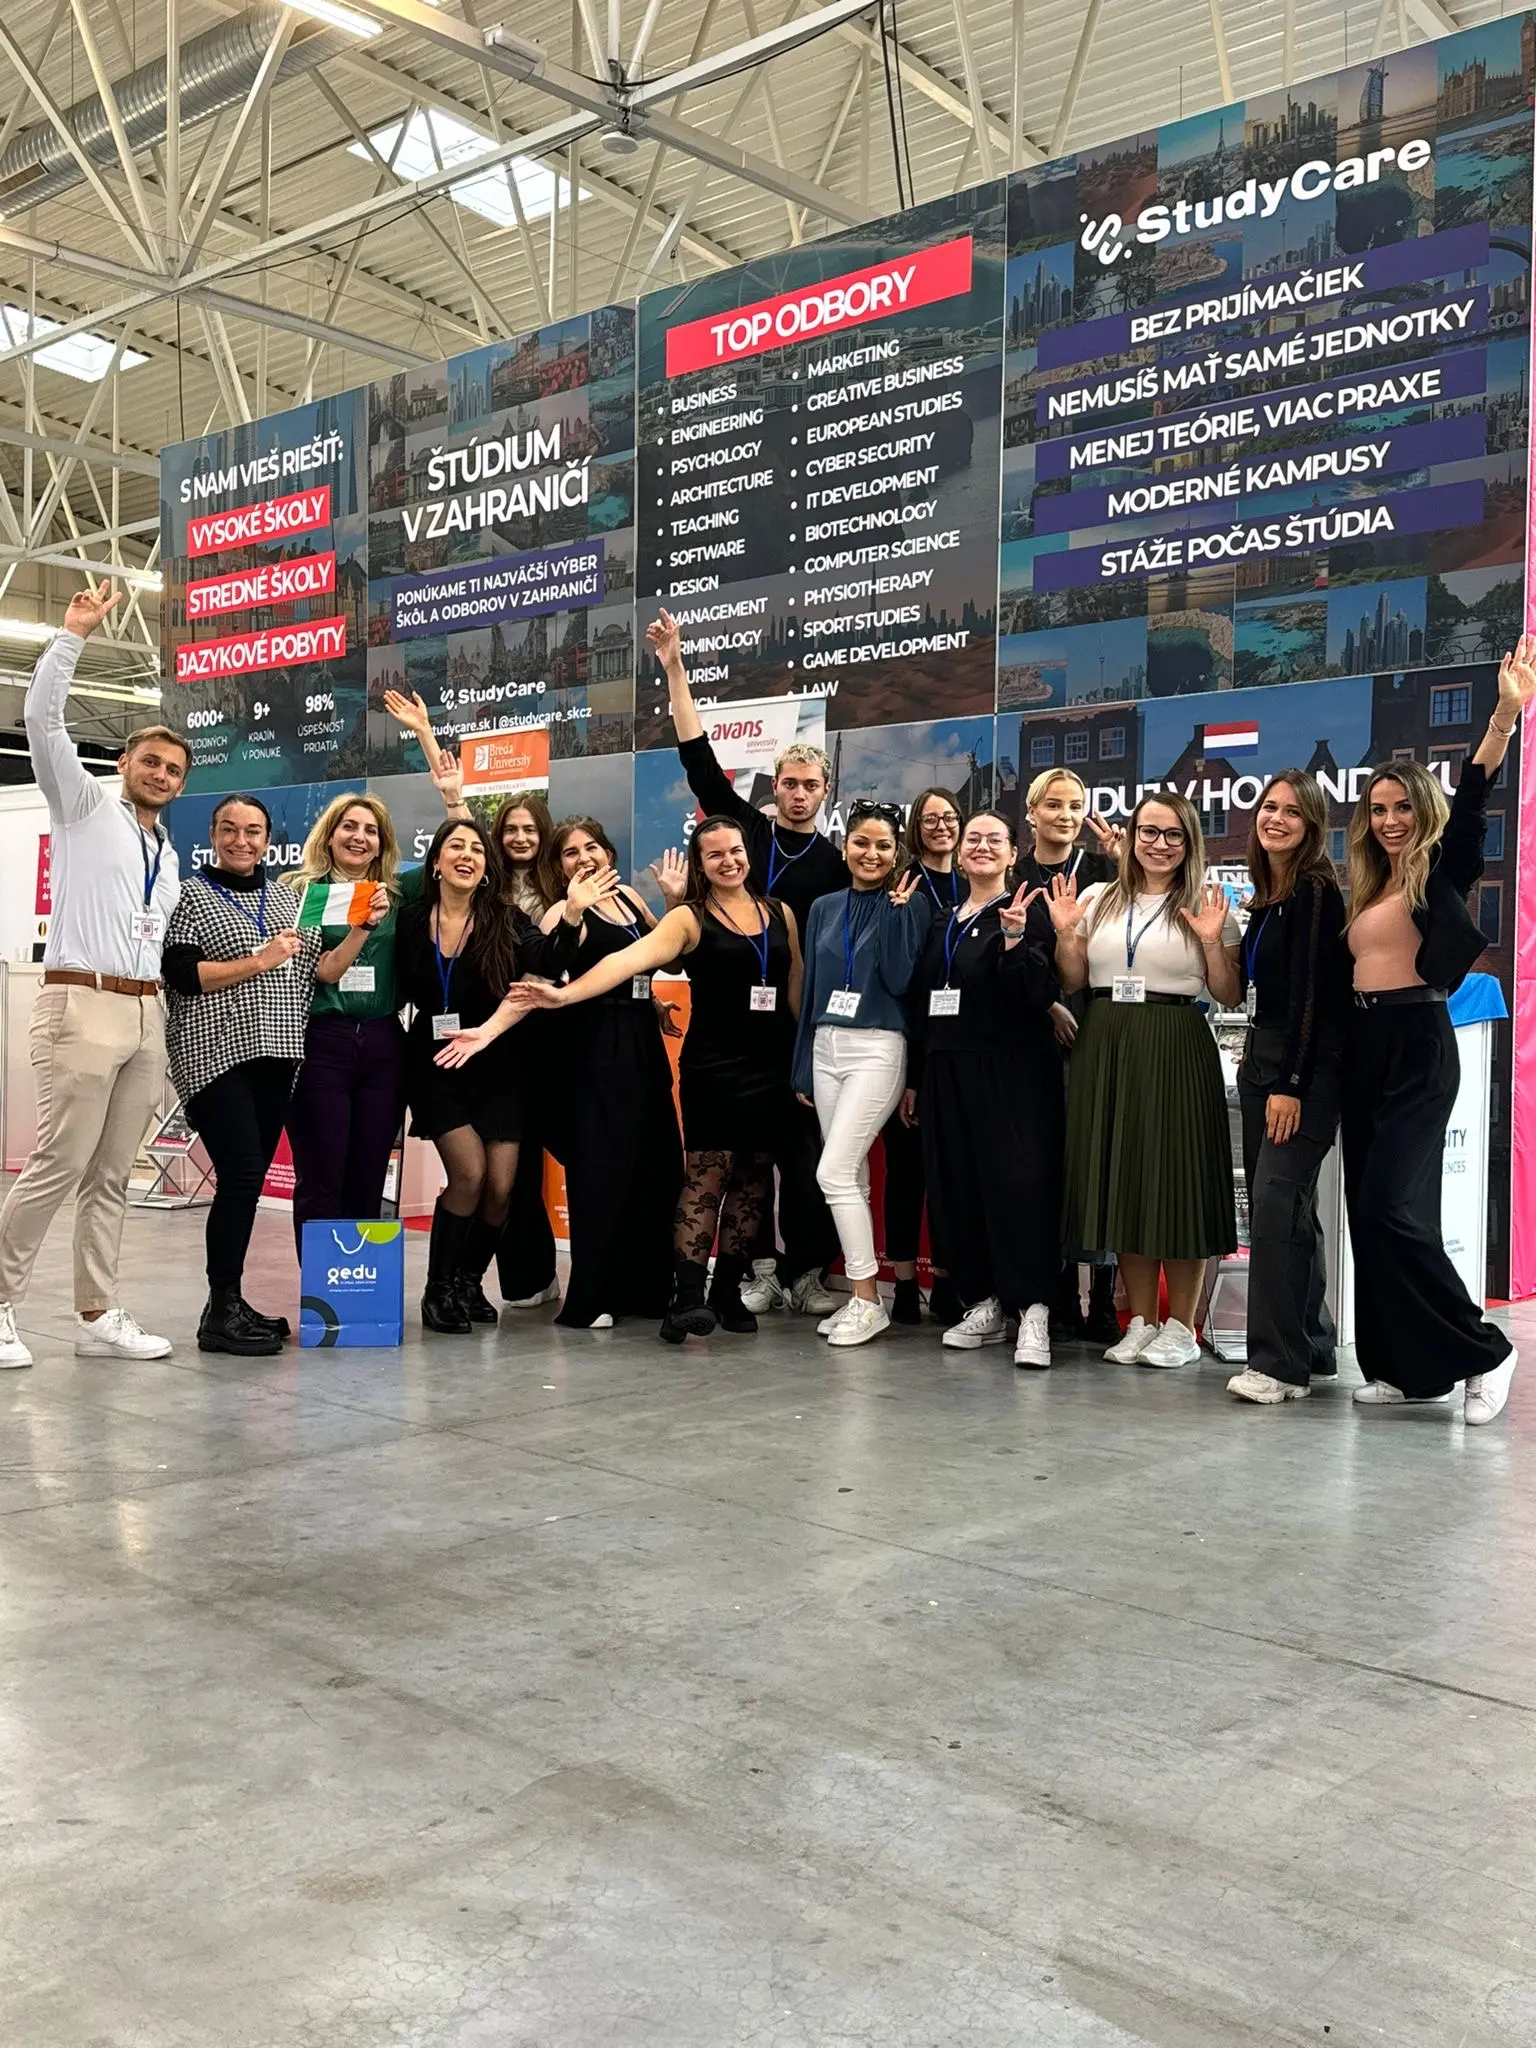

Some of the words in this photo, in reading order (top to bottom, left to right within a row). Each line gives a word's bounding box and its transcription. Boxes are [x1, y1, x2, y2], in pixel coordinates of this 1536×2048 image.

[1136, 139, 1431, 245] StudyCare
[711, 318, 772, 356] TOP
[776, 265, 916, 338] ODBORY
[1130, 310, 1182, 345] BEZ
[1185, 262, 1367, 334] PRIJÍMAČIEK
[807, 339, 899, 379] MARKETING
[1048, 369, 1160, 420] NEMUSÍŠ
[1163, 352, 1222, 394] MAŤ
[1225, 333, 1306, 380] SAMÉ
[1311, 300, 1475, 361] JEDNOTKY
[671, 384, 737, 414] BUSINESS
[807, 378, 883, 412] CREATIVE
[884, 356, 964, 393] BUSINESS
[671, 408, 763, 445] ENGINEERING
[806, 408, 893, 445] EUROPEAN
[894, 391, 963, 423] STUDIES
[1069, 430, 1155, 469] MENEJ
[1158, 402, 1260, 448] TEÓRIE,
[1263, 391, 1335, 430] VIAC
[1338, 369, 1442, 415] PRAXE
[180, 479, 191, 503] S
[191, 465, 237, 500] NAMI
[240, 448, 280, 488] VIEŠ
[283, 430, 344, 477] RIEŠIŤ:
[427, 423, 561, 492] ŠTÚDIUM
[670, 441, 762, 476] PSYCHOLOGY
[806, 450, 858, 477] CYBER
[858, 432, 935, 464] SECURITY
[401, 506, 424, 543] V
[425, 455, 593, 540] ZAHRANIČÍ
[670, 470, 773, 507] ARCHITECTURE
[806, 491, 820, 509] IT
[821, 466, 939, 506] DEVELOPMENT
[1108, 467, 1242, 518] MODERNÉ
[1245, 441, 1391, 491] KAMPUSY
[191, 503, 262, 549] VYSOKÉ
[264, 494, 325, 534] ŠKOLY
[671, 509, 740, 537] TEACHING
[805, 501, 937, 542] BIOTECHNOLOGY
[669, 539, 746, 567] SOFTWARE
[804, 541, 890, 574] COMPUTER
[891, 530, 961, 558] SCIENCE
[1100, 536, 1183, 578] STÁŽE
[1187, 525, 1281, 564] POČAS
[1286, 506, 1394, 548] ŠTÚDIA
[189, 570, 268, 614] STREDNÉ
[271, 560, 332, 597] ŠKOLY
[396, 581, 467, 607] PONÚKAME
[469, 579, 481, 593] TI
[483, 558, 549, 591] NAJVÄČŠÍ
[550, 554, 598, 577] VÝBER
[670, 575, 719, 598] DESIGN
[804, 570, 934, 606] PHYSIOTHERAPY
[396, 608, 428, 628] ŠKÔL
[429, 611, 440, 623] A
[441, 595, 506, 620] ODBOROV
[509, 592, 520, 608] V
[522, 573, 599, 606] ZAHRANIČÍ
[670, 597, 768, 626] MANAGEMENT
[803, 614, 853, 639] SPORT
[855, 605, 921, 632] STUDIES
[178, 636, 268, 677] JAZYKOVÉ
[271, 624, 345, 664] POBYTY
[680, 629, 762, 655] RIMINOLOGY
[803, 648, 848, 670] GAME
[850, 631, 970, 664] DEVELOPMENT
[457, 680, 546, 705] StudyCare
[687, 665, 729, 684] URISM
[187, 709, 224, 729] 6000+
[253, 701, 270, 720] 9+
[305, 693, 334, 713] 98%
[400, 717, 491, 740] wwtudycare.sk
[499, 706, 592, 728] @studycare_skcz
[711, 720, 763, 741] avans
[187, 735, 228, 749] TUDIJNÝCH
[242, 752, 248, 761] V
[249, 746, 281, 759] PONUKE
[248, 730, 275, 743] KRAJÍN
[489, 742, 514, 756] Breda
[191, 752, 229, 766] OGRAMOV
[489, 753, 532, 769] University
